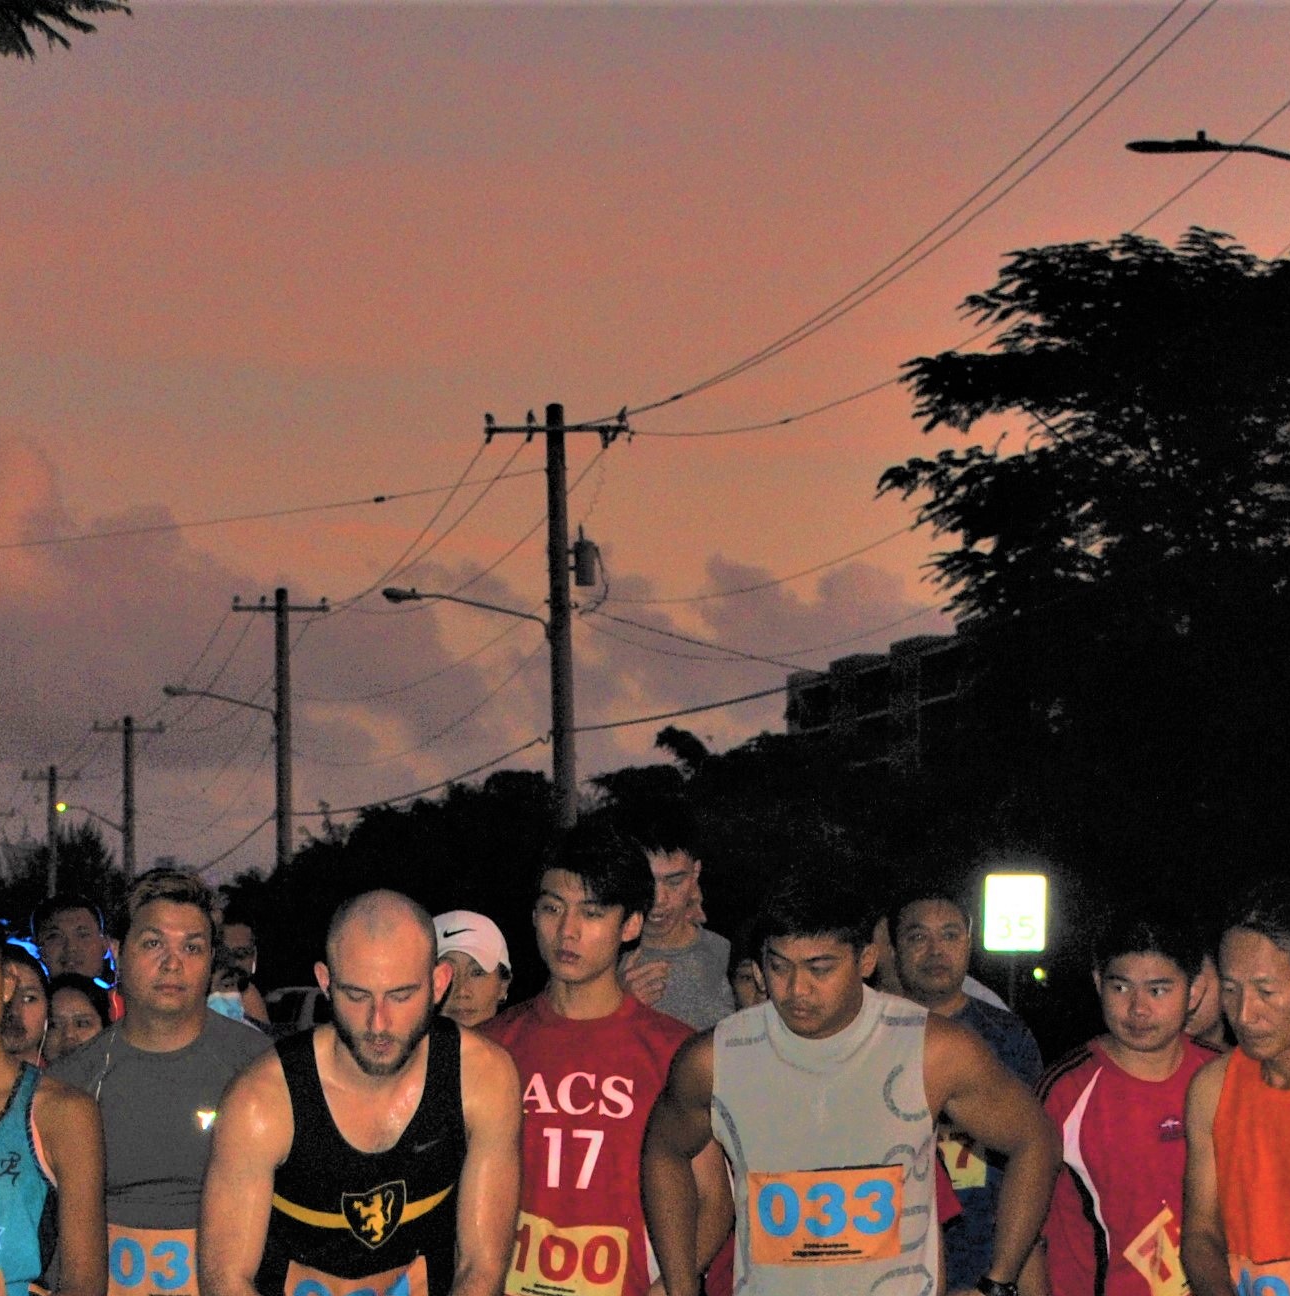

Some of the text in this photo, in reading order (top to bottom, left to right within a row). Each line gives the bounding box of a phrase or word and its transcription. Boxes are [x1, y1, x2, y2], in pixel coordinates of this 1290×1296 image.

[997, 914, 1037, 940] 35
[522, 1071, 634, 1119] ACS
[543, 1127, 605, 1190] 17
[757, 1178, 897, 1238] 033
[109, 1237, 192, 1290] 03
[515, 1222, 621, 1285] 100
